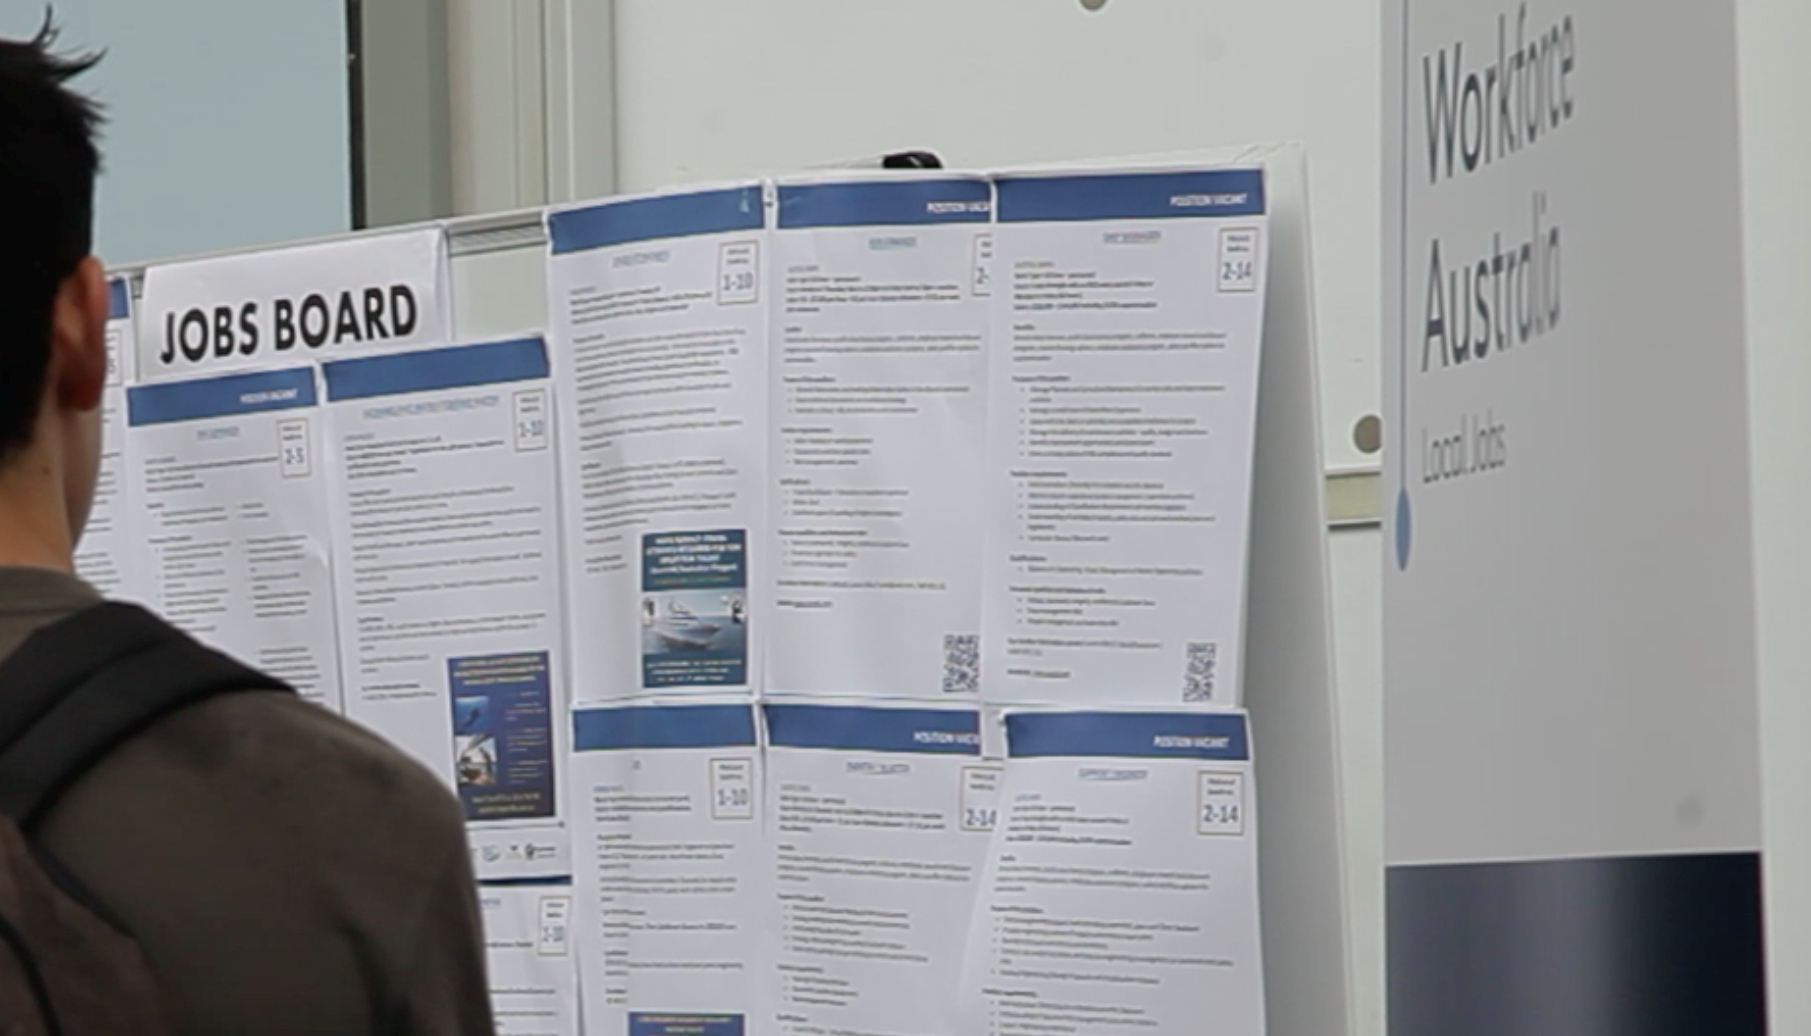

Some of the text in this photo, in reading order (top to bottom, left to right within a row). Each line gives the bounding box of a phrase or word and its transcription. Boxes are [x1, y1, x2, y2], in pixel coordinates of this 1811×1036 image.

[1422, 1, 1575, 186] Workforce
[723, 271, 754, 291] 1-10
[1222, 261, 1252, 281] 2-14
[1421, 191, 1561, 375] Australia
[160, 284, 417, 365] JOBS BOARD
[914, 731, 955, 744] POSITION
[1153, 735, 1192, 748] POSITION
[717, 788, 748, 806] 1-10
[965, 809, 997, 827] 2-14
[1203, 804, 1239, 824] 2-14
